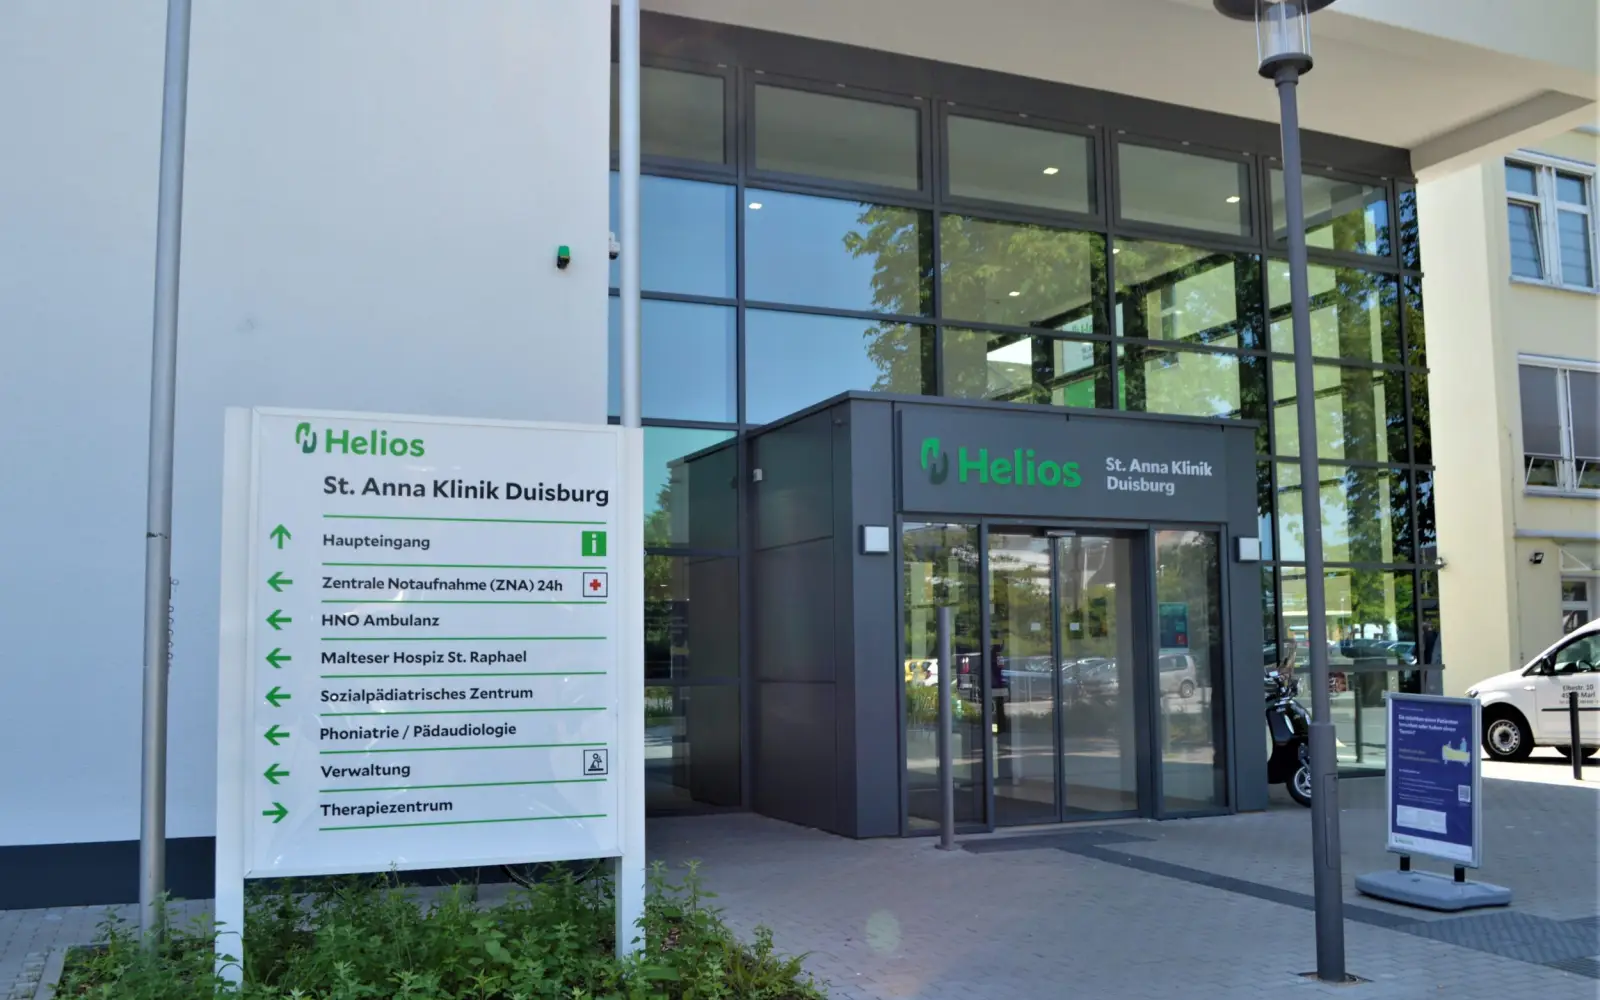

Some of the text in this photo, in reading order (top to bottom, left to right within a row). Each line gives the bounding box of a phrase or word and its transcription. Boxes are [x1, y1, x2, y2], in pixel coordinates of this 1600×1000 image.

[325, 428, 425, 457] Helios
[958, 447, 1082, 488] Helios
[1105, 456, 1213, 477] St. Anna Klinik
[323, 475, 610, 508] St. Anna Klinik Duisburg
[1106, 476, 1175, 496] Duisburg
[323, 533, 431, 551] Haupteingang
[322, 576, 563, 593] Zentrale Notaufnahme (ZNA) 24h
[321, 612, 440, 627] HNO Ambulanz
[320, 650, 528, 667] Malteser Hospiz St. Raphael
[320, 686, 534, 705] Sozialpädiatrisches Zentrum
[319, 722, 517, 741] Phoniatrie / Pädaudiologie
[320, 763, 411, 779] Verwaltung
[319, 800, 453, 818] Therapiezentrum
